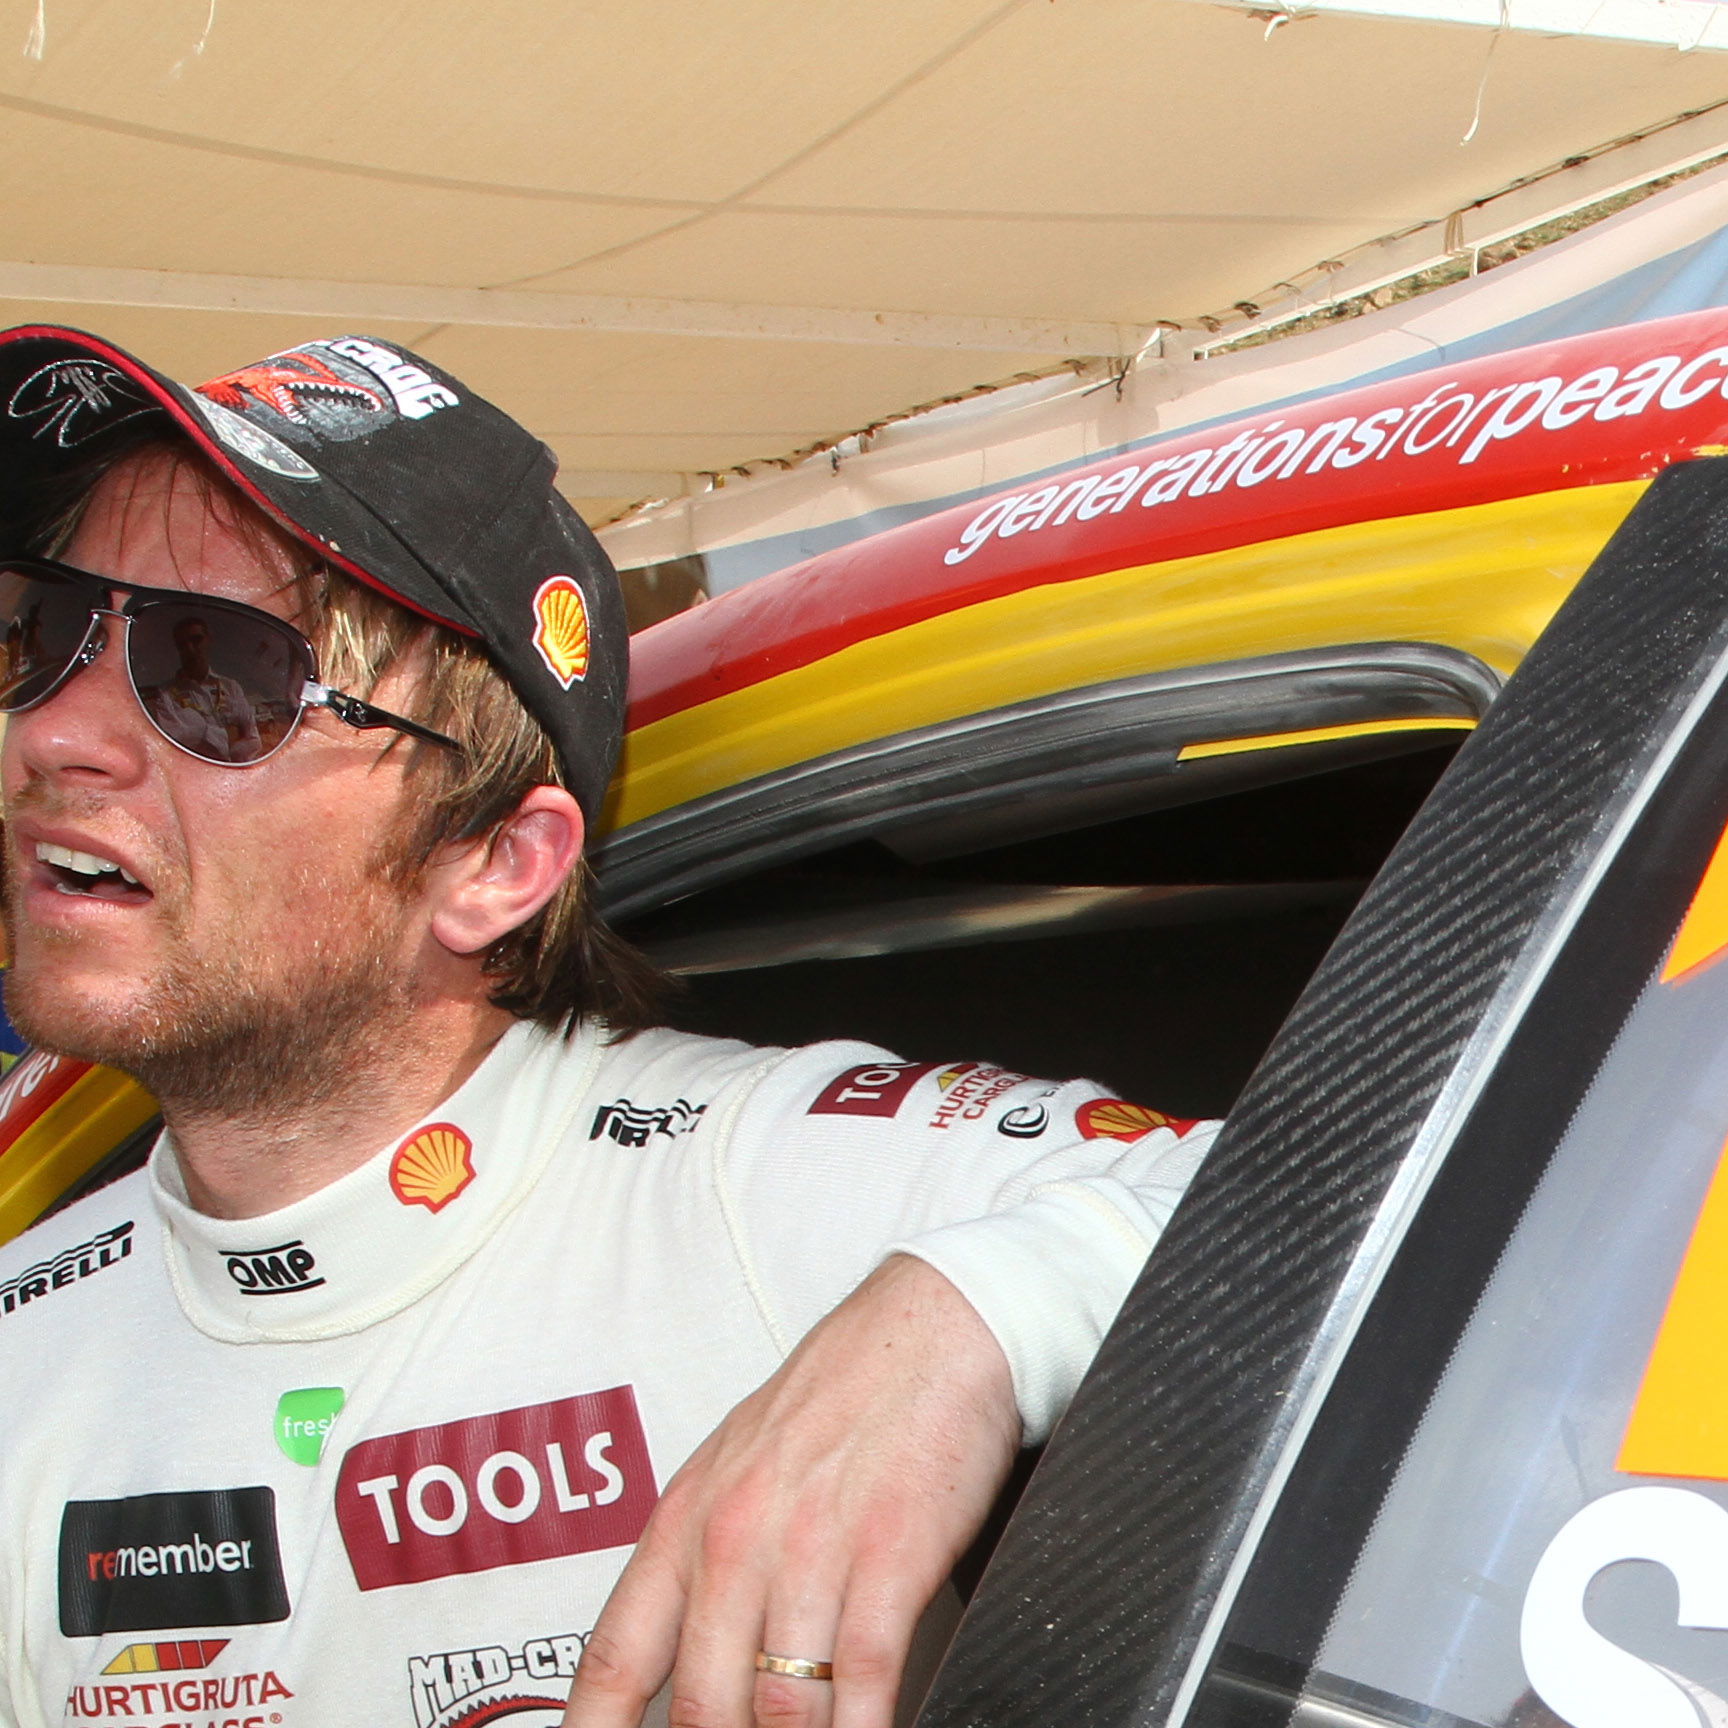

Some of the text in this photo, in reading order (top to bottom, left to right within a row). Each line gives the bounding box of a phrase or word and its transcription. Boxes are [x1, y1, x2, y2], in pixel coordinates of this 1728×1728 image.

[0, 1220, 135, 1318] IRELLI
[226, 1248, 316, 1289] OMP
[357, 1431, 625, 1544] TOOLS
[87, 1532, 252, 1581] remember
[65, 1670, 295, 1718] HURTIGRUTA
